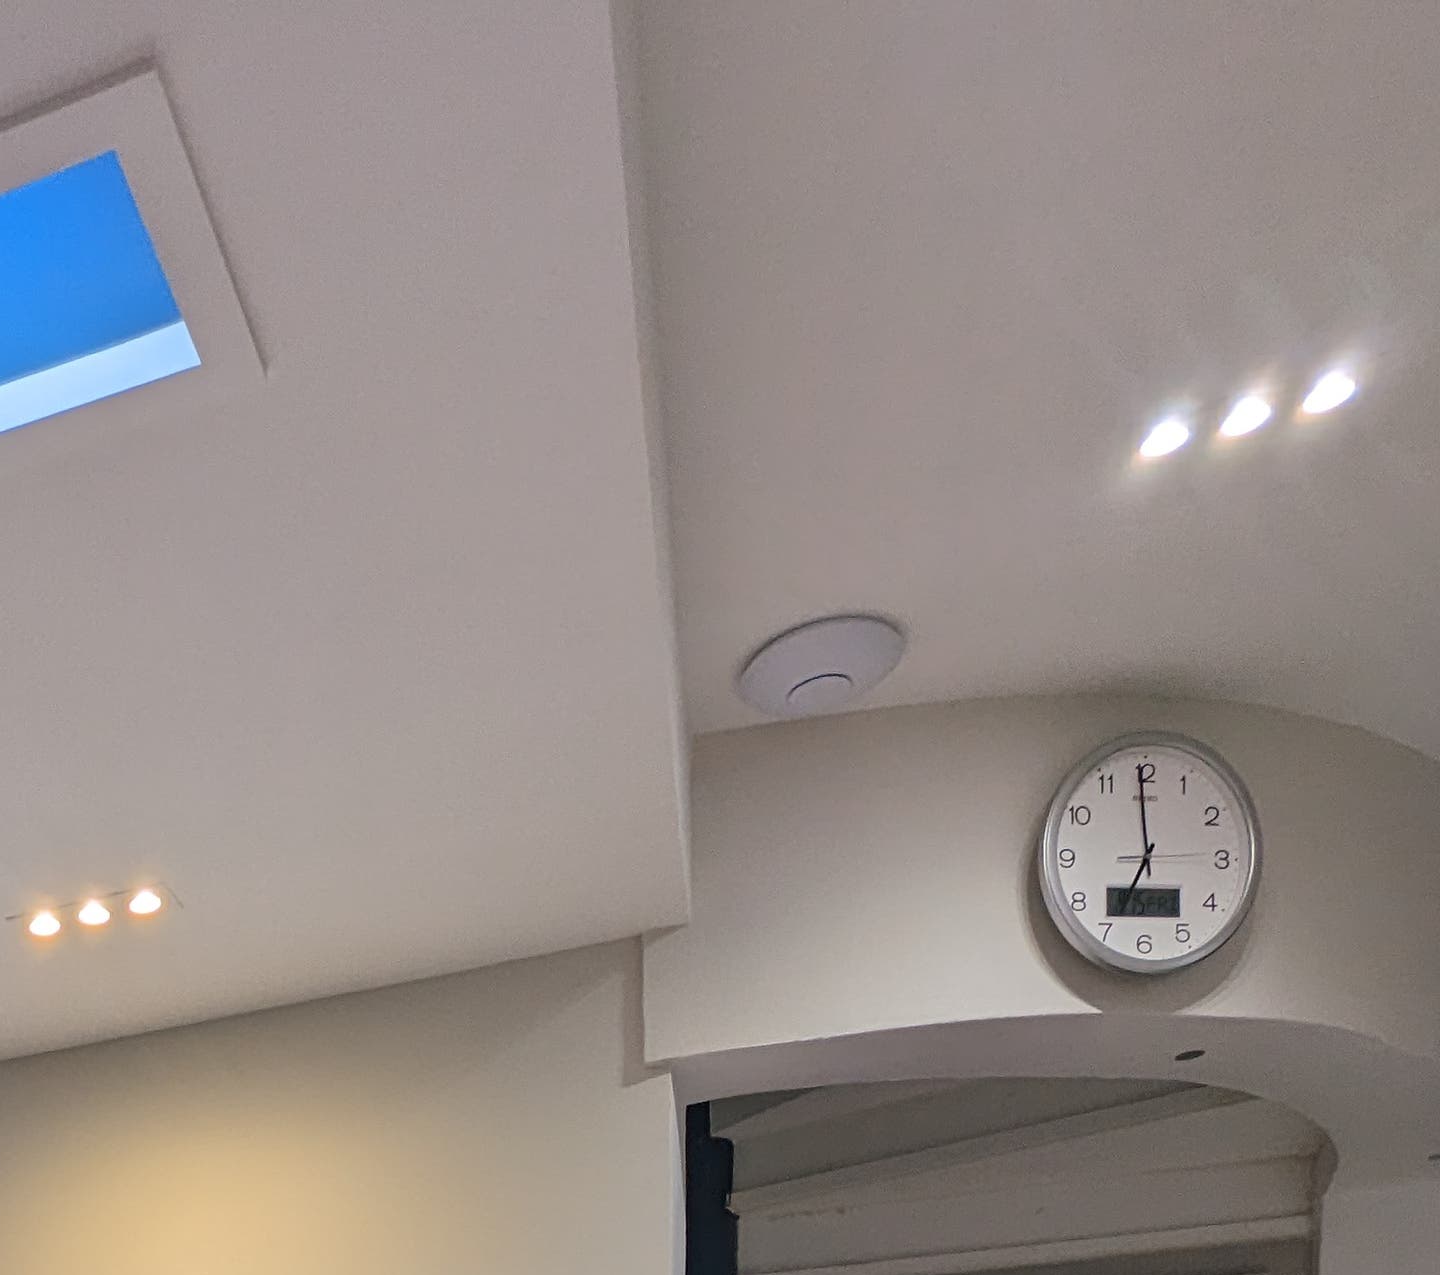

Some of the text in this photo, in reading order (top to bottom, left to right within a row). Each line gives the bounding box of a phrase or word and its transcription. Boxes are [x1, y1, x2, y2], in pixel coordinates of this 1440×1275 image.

[1136, 763, 1156, 784] 12
[1098, 774, 1115, 795] 11
[1179, 775, 1187, 795] 1
[1068, 805, 1091, 826] 10
[1204, 806, 1220, 827] 2
[1059, 849, 1076, 869] 9
[1214, 850, 1230, 870] 3
[1071, 892, 1087, 912] 8
[1202, 892, 1218, 912] 4
[1098, 922, 1113, 943] 7
[1175, 923, 1191, 944] 5
[1136, 934, 1153, 955] 6
